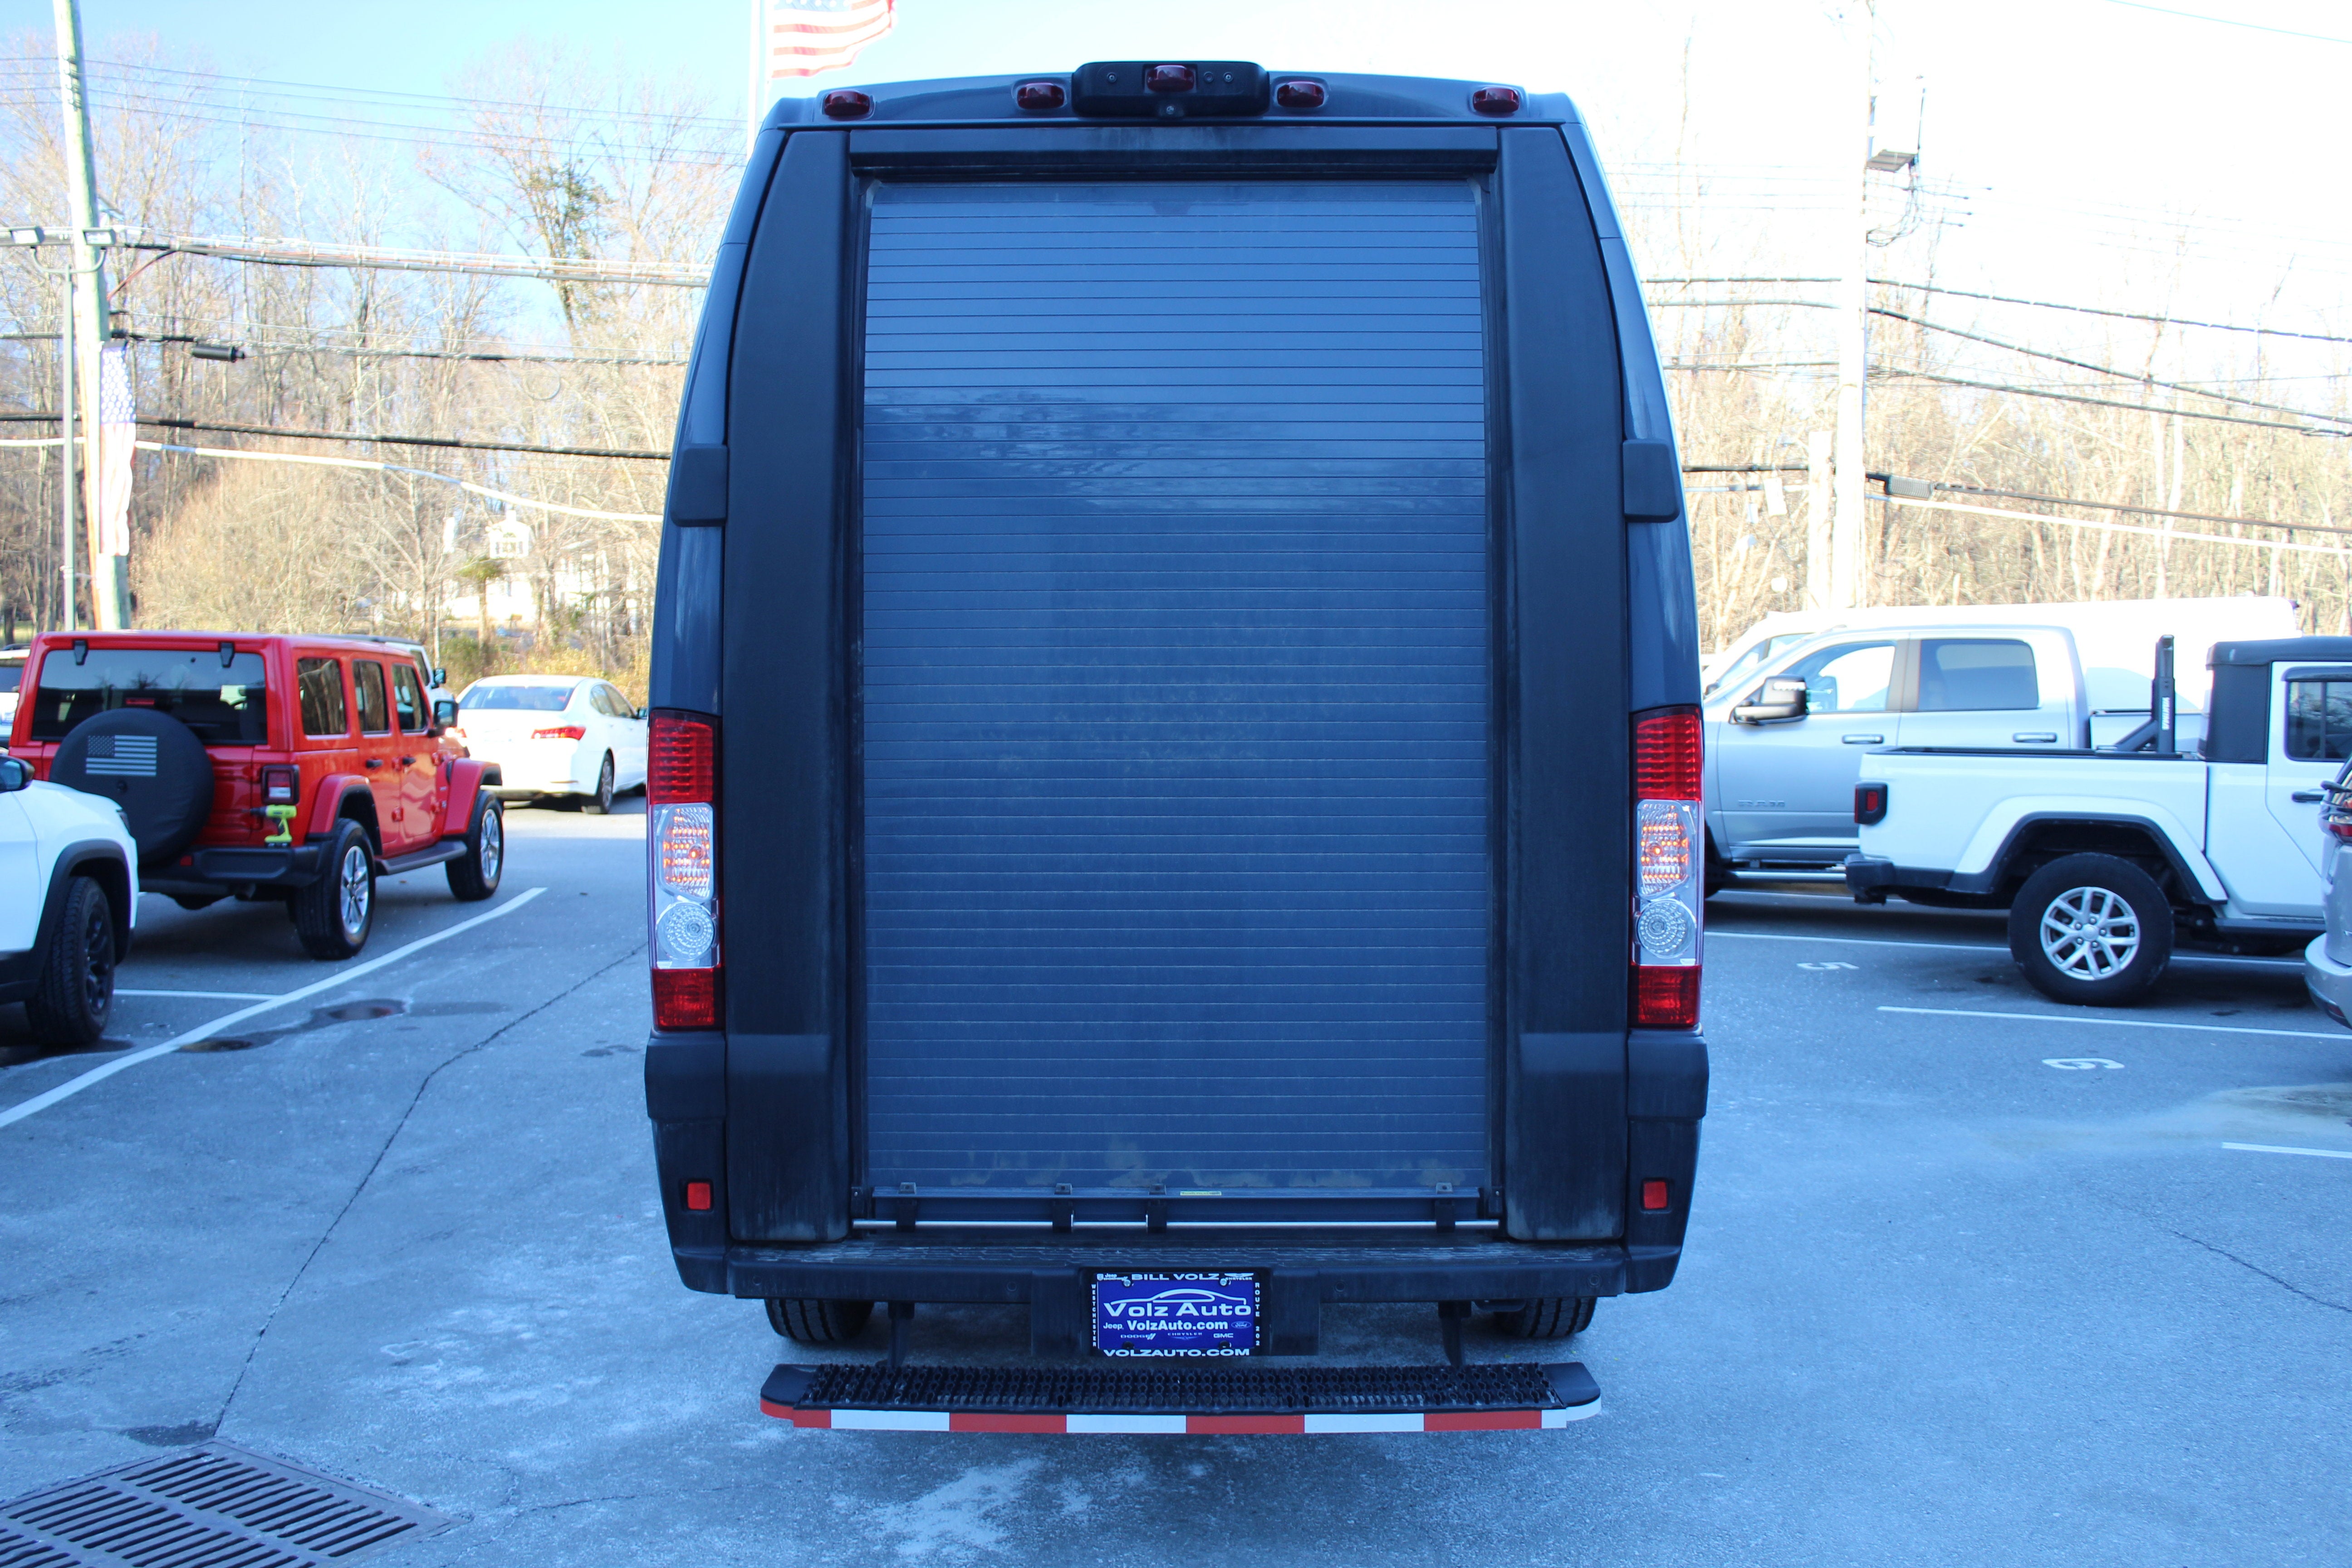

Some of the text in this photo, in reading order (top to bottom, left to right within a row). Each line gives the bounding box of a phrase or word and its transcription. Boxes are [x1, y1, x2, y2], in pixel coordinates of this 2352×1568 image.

[2161, 697, 2170, 730] YAKIMA
[1103, 1302, 1251, 1317] Volz Auto
[1103, 1322, 1123, 1330] Jeep
[1127, 1320, 1228, 1331] VolzAuto.com
[1103, 1349, 1250, 1357] VOLZAUTO.COM
